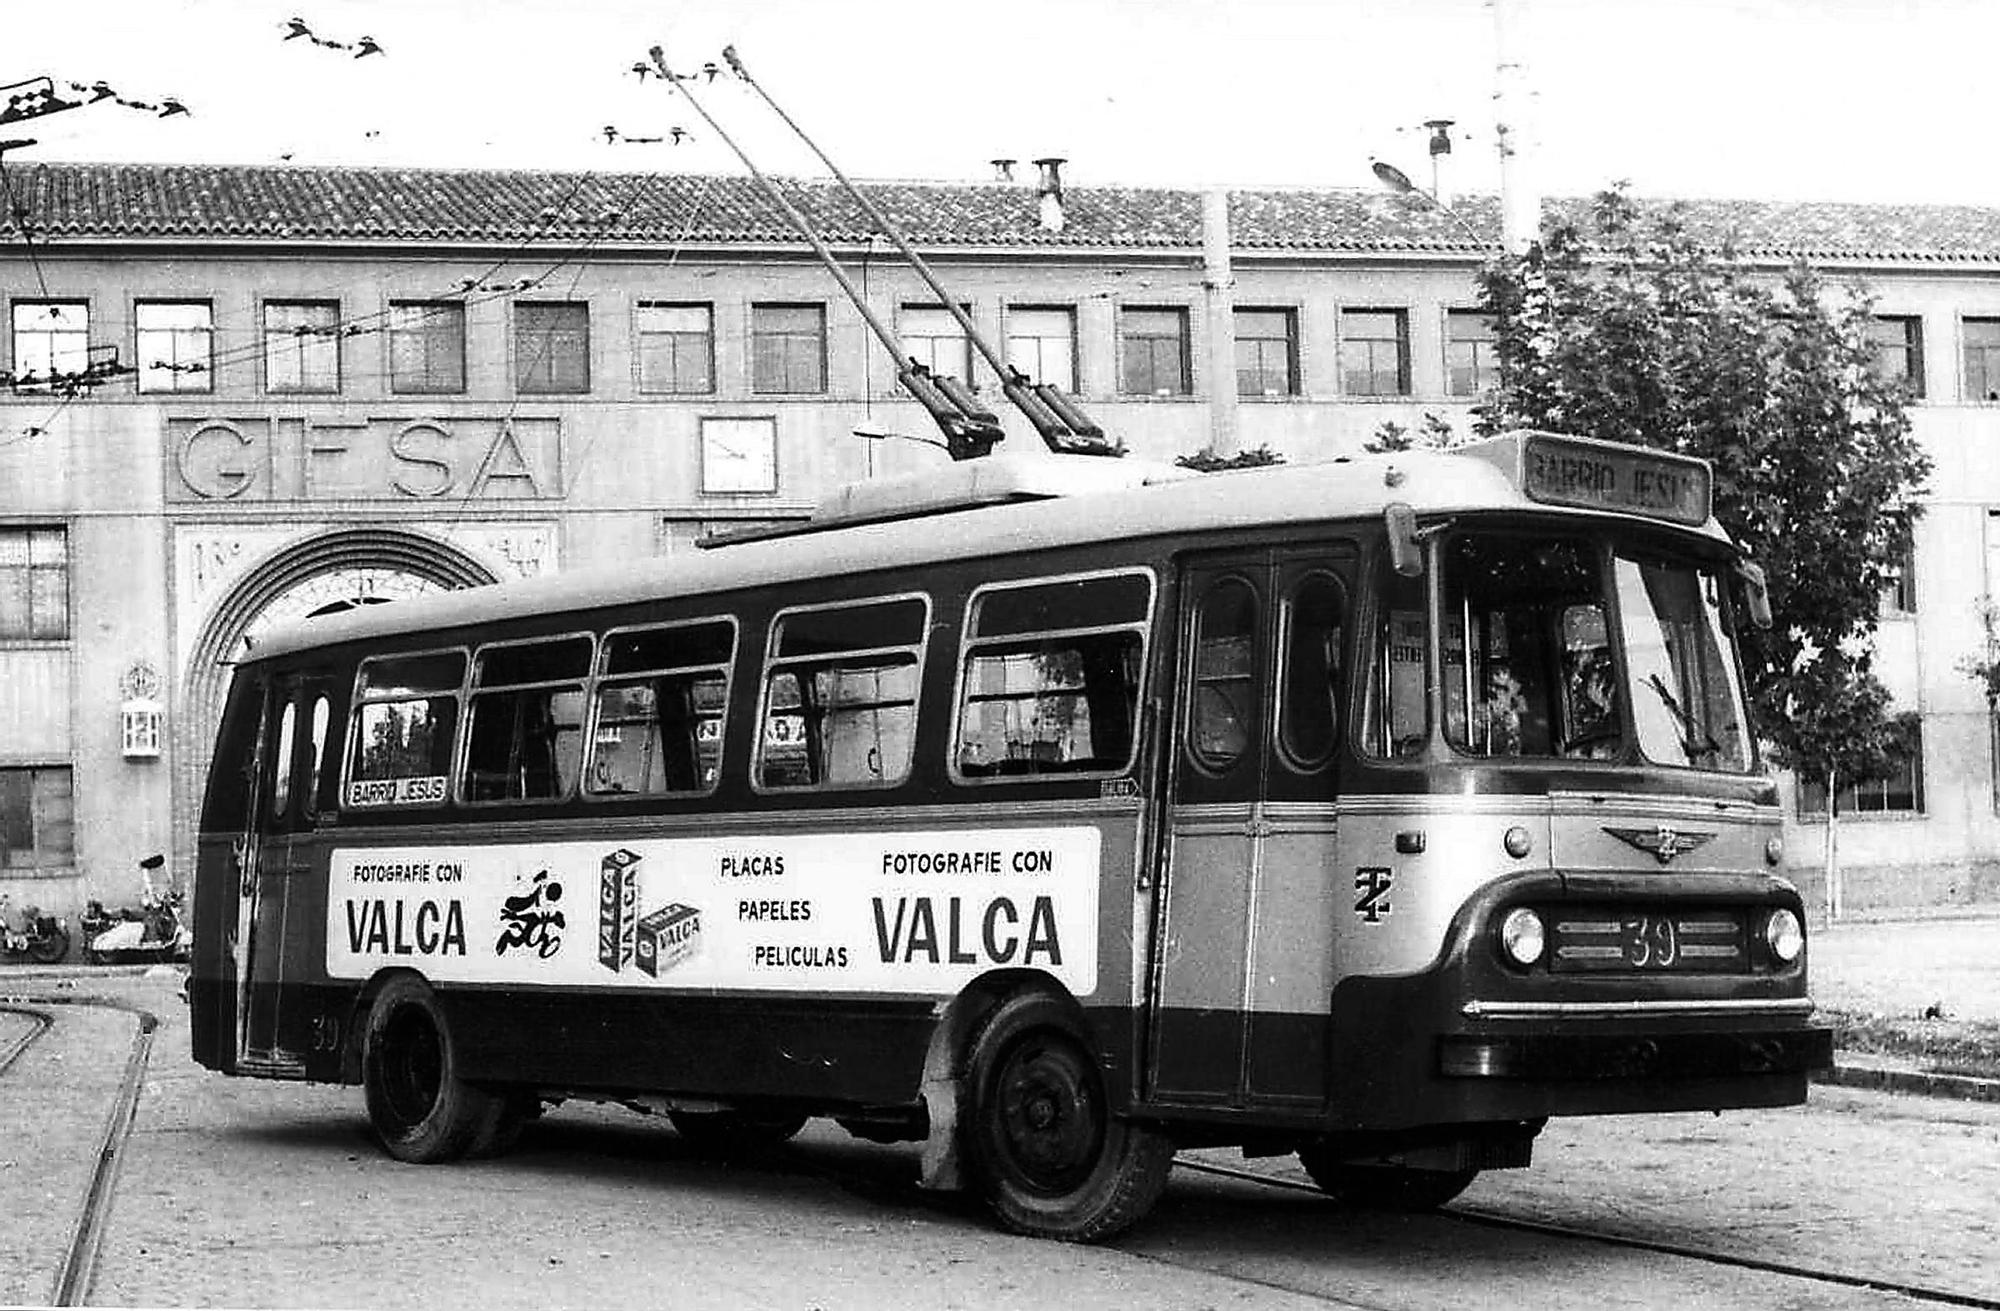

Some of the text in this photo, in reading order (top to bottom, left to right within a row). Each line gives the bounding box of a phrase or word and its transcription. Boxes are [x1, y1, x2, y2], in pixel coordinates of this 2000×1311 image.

[177, 418, 540, 499] GIESA
[353, 864, 462, 882] FOTOGRAFIE CON
[721, 856, 785, 877] PLACAS
[883, 850, 1052, 875] FOTOGRAFIE CON
[739, 900, 811, 922] PAPELES
[346, 899, 467, 956] VALCA
[872, 896, 1063, 966] VALCA
[1626, 918, 1675, 967] 39
[755, 946, 848, 968] PELICULAS
